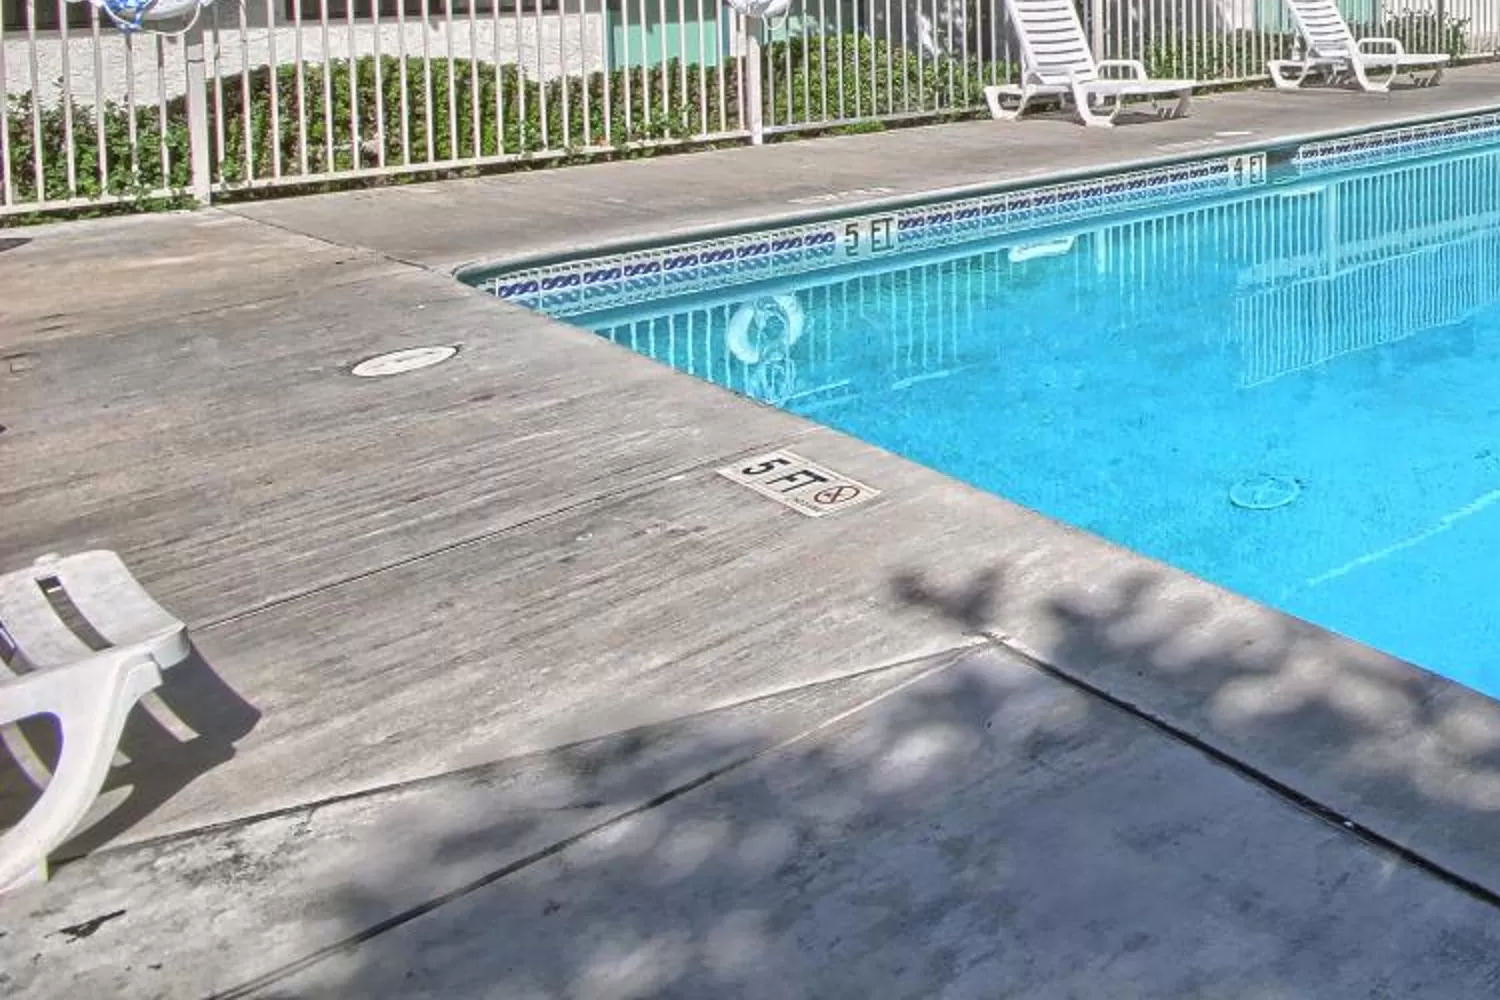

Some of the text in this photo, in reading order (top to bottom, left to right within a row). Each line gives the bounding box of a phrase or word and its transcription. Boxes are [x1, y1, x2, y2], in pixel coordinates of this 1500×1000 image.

[844, 217, 895, 245] 5 FT
[742, 458, 829, 493] 5 FT
